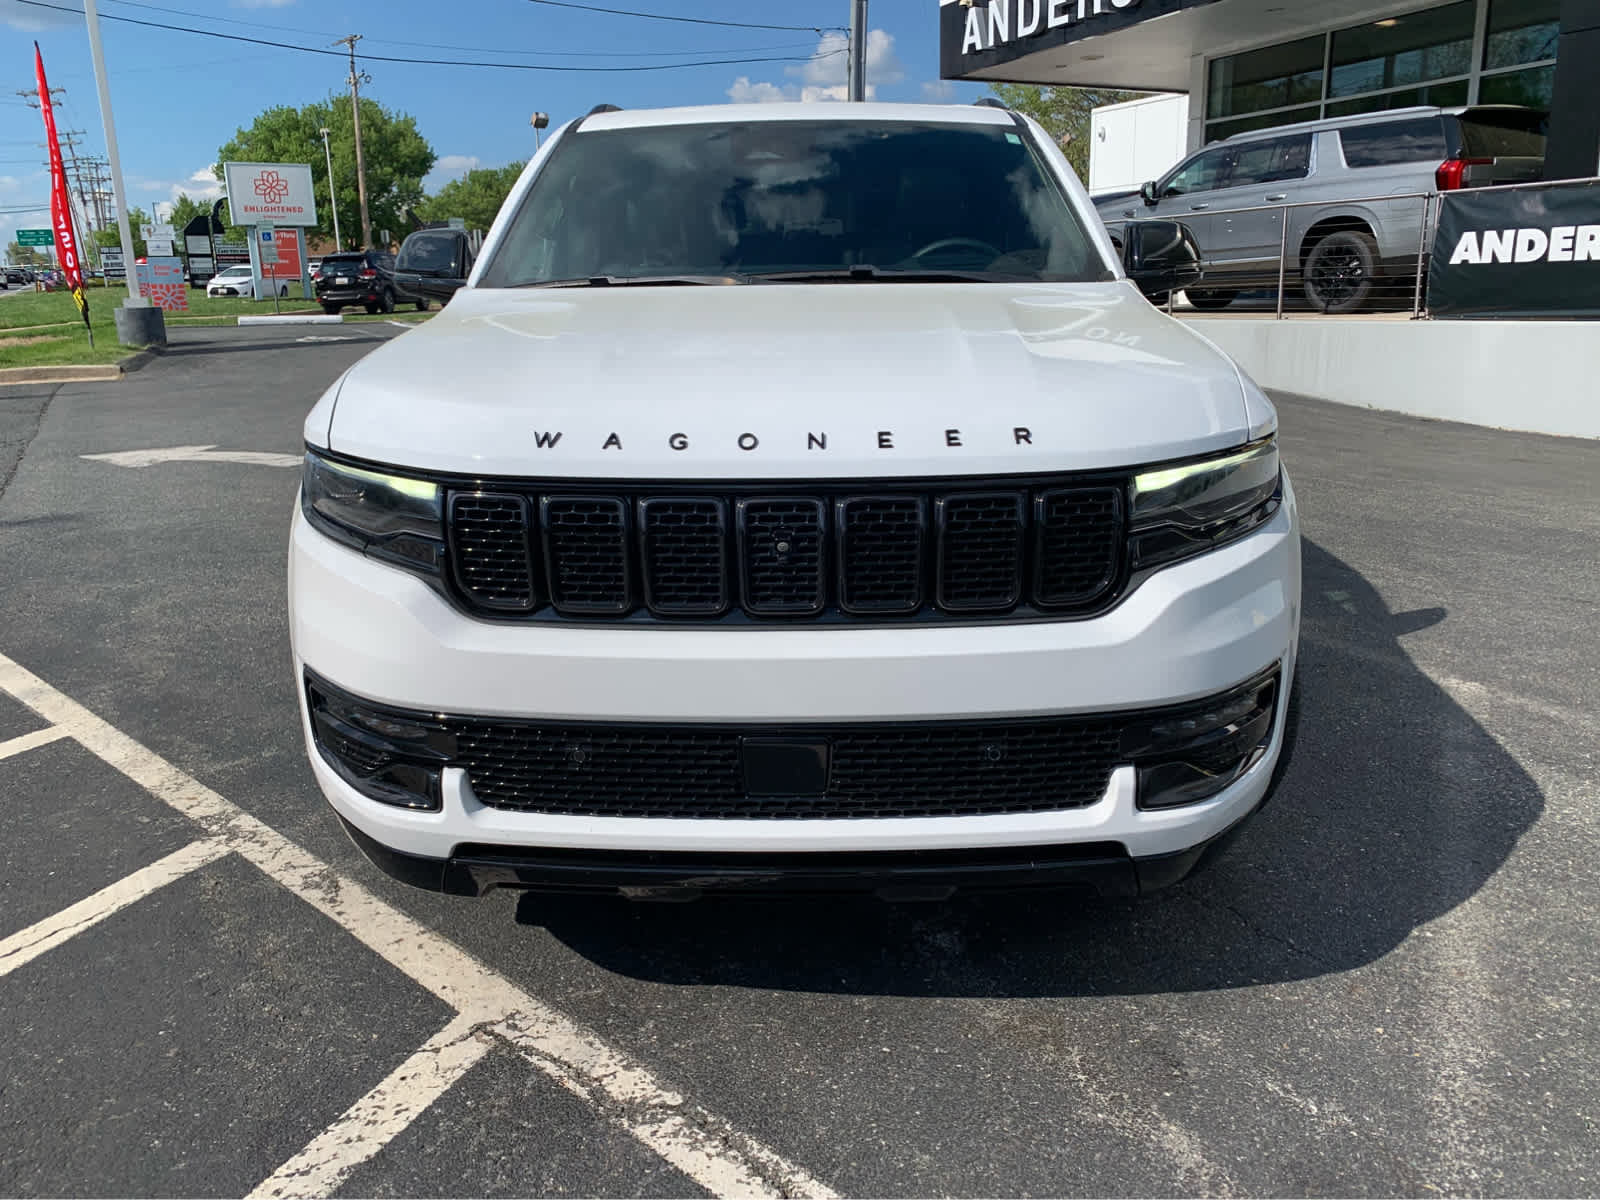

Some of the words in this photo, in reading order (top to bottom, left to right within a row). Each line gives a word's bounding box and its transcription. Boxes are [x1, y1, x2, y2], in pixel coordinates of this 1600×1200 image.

[961, 0, 1132, 54] ANDE
[244, 205, 304, 213] ENLIGHTENED
[534, 427, 1033, 450] WAGONEER
